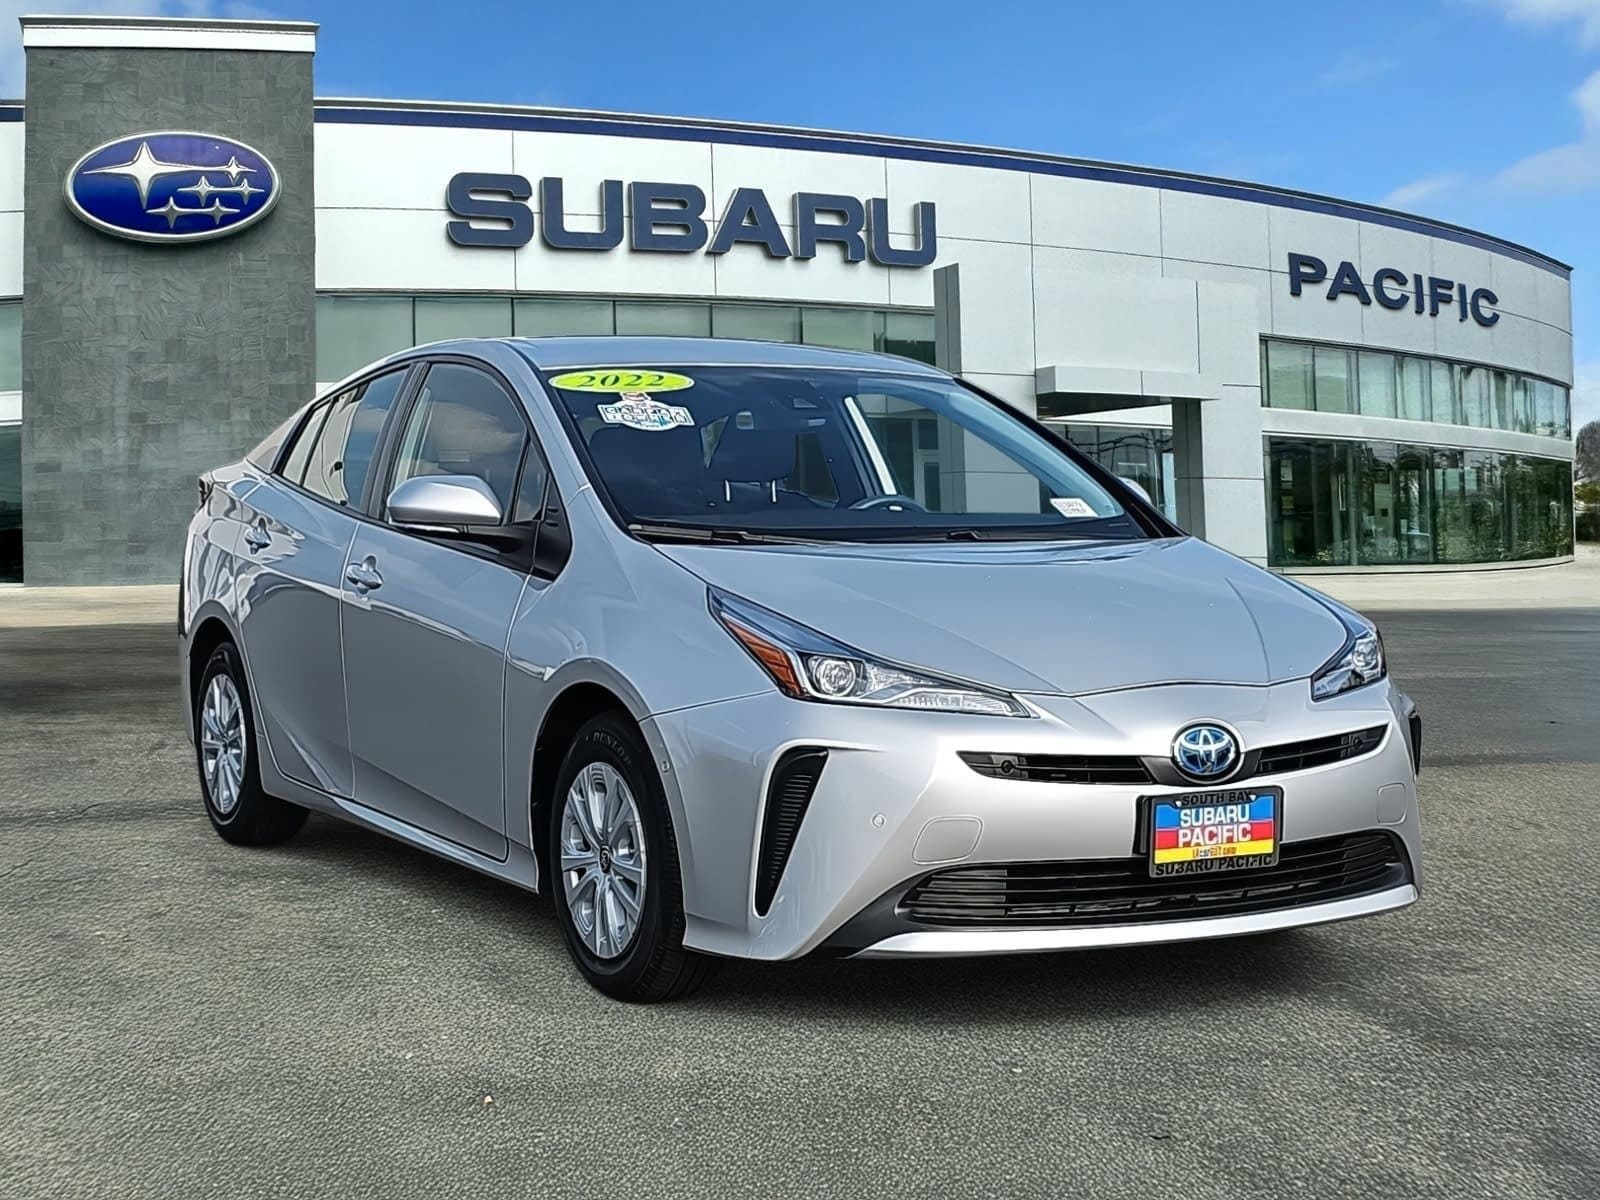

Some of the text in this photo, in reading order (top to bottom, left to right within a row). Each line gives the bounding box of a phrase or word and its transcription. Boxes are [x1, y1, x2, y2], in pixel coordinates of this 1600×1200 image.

[446, 172, 937, 268] SUBARU
[1288, 252, 1500, 327] PACIFIC
[576, 374, 665, 387] 2022
[1181, 791, 1252, 806] SOUTH BAY
[1180, 803, 1250, 827] SUBARU
[1178, 823, 1252, 848] PACIFIC
[1155, 855, 1274, 876] SUBARU PACIFIC
